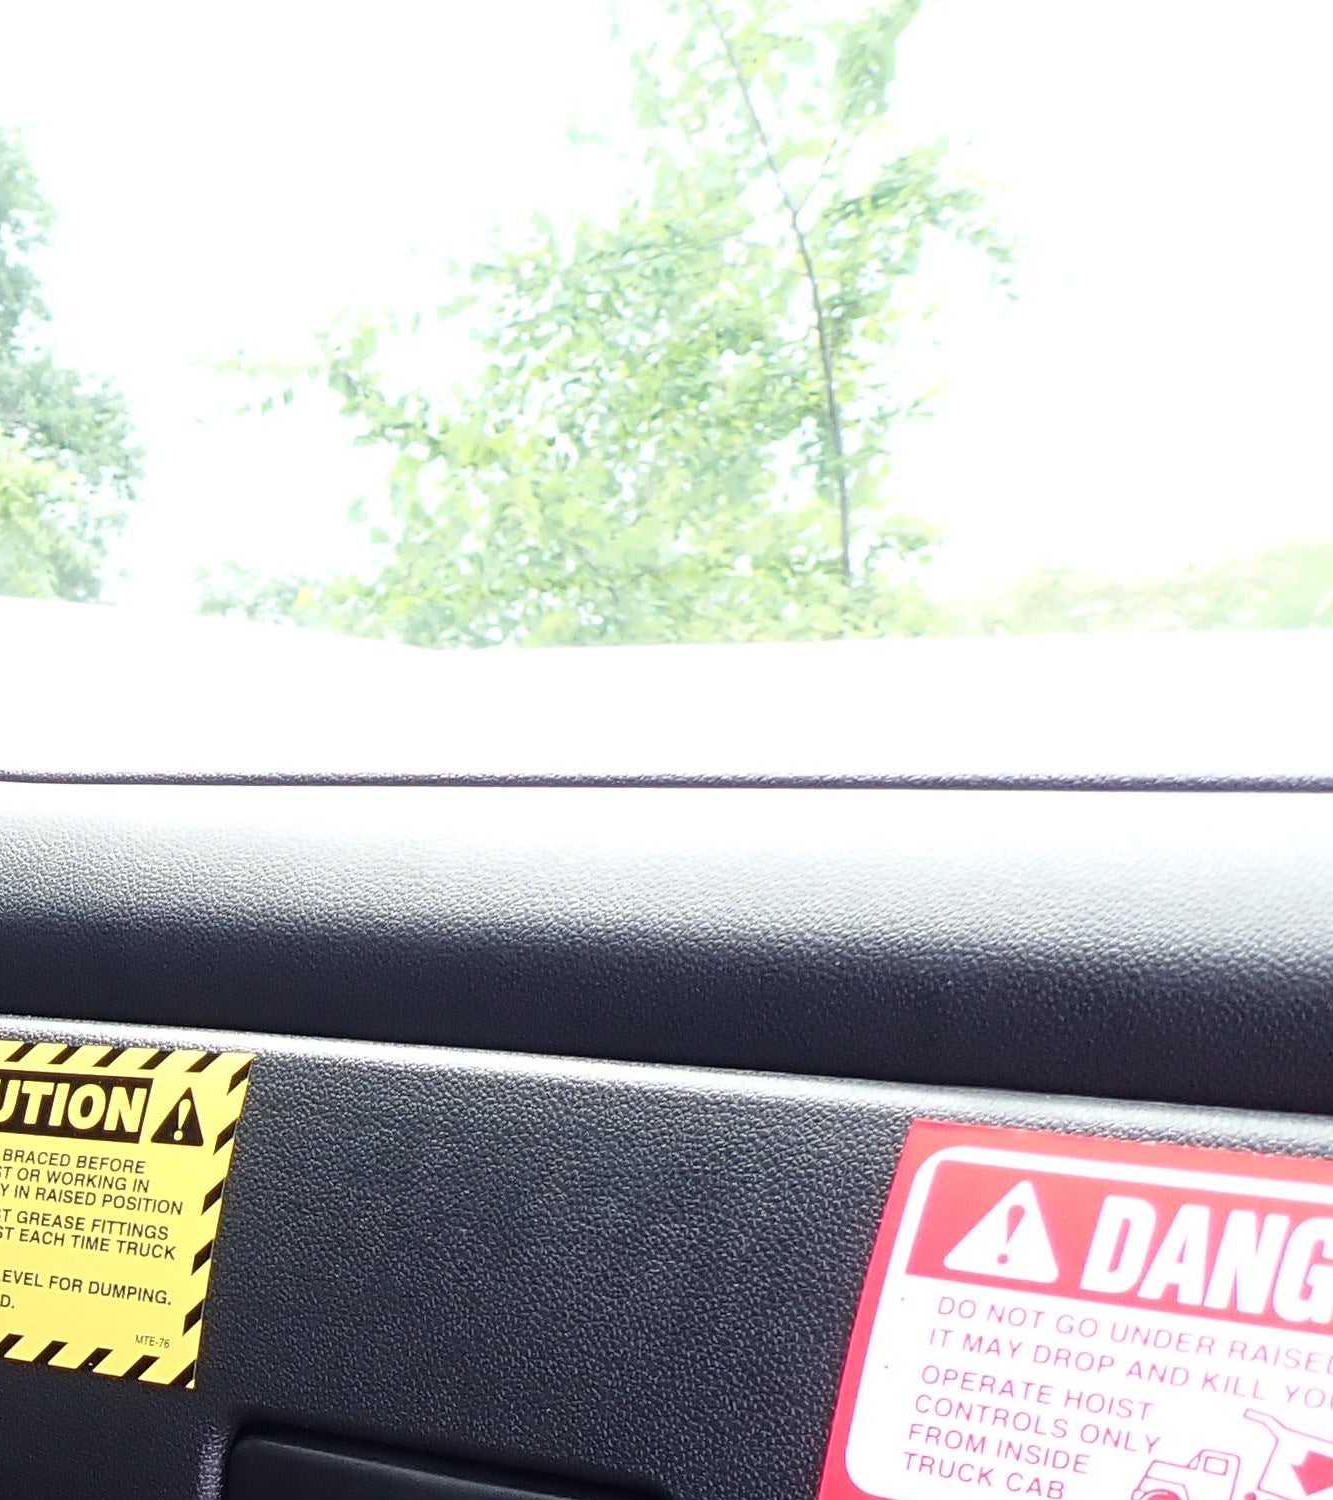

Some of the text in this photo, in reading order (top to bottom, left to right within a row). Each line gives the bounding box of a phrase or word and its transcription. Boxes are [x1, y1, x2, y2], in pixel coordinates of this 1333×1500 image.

[3, 1149, 70, 1166] BRACED
[76, 1156, 145, 1174] BEFORE
[17, 1168, 40, 1182] OR
[47, 1170, 127, 1190] WORKING
[133, 1179, 149, 1193] IN
[14, 1185, 29, 1199] IN
[35, 1187, 96, 1206] RAISED
[102, 1194, 183, 1215] POSITION
[17, 1211, 85, 1231] GREASE
[91, 1219, 168, 1240] FITTINGS
[19, 1228, 65, 1246] EACH
[71, 1235, 111, 1252] TIME
[117, 1240, 176, 1259] TRUCK
[49, 1276, 83, 1293] FOR
[89, 1281, 171, 1305] DUMPING.
[938, 1296, 976, 1318] DO
[987, 1304, 1045, 1328] NOT
[1056, 1315, 1098, 1338] GO
[1111, 1323, 1215, 1355] UNDER
[930, 1328, 1333, 1409] IT MAY DROP AND KILL YO
[922, 1365, 1153, 1420] OPERATE HOIST
[915, 1395, 1160, 1454] CONTROLS ONLY
[909, 1424, 1089, 1473] FROM INSIDE
[905, 1452, 1064, 1499] TRUCK CAB
